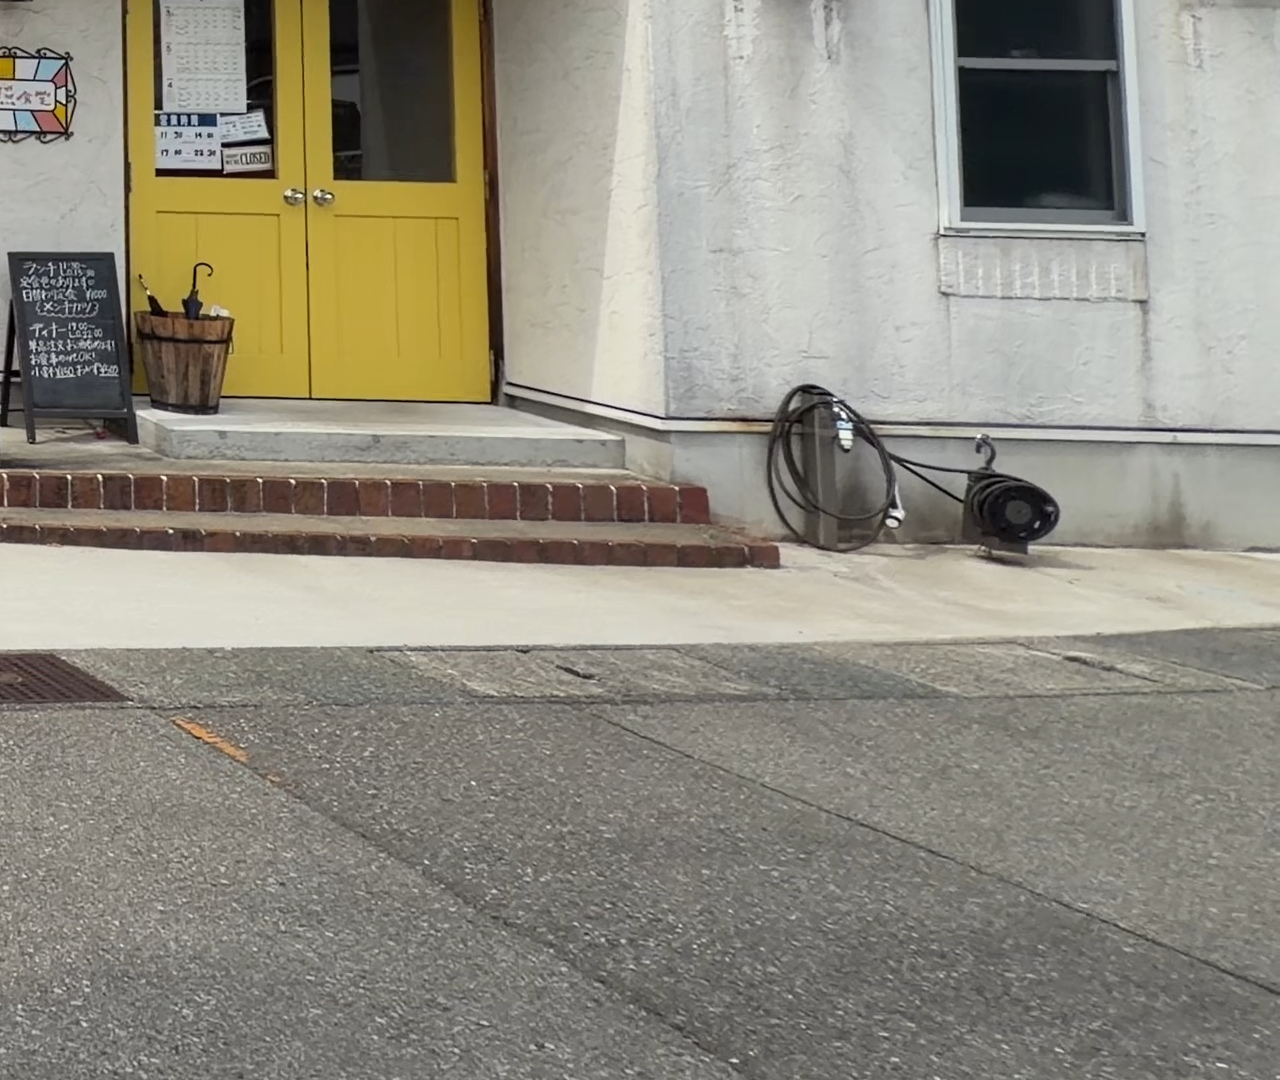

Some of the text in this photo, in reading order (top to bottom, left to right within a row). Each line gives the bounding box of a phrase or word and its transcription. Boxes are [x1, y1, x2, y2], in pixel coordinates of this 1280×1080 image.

[240, 151, 270, 165] CLOSED
[22, 261, 57, 277] ランチ
